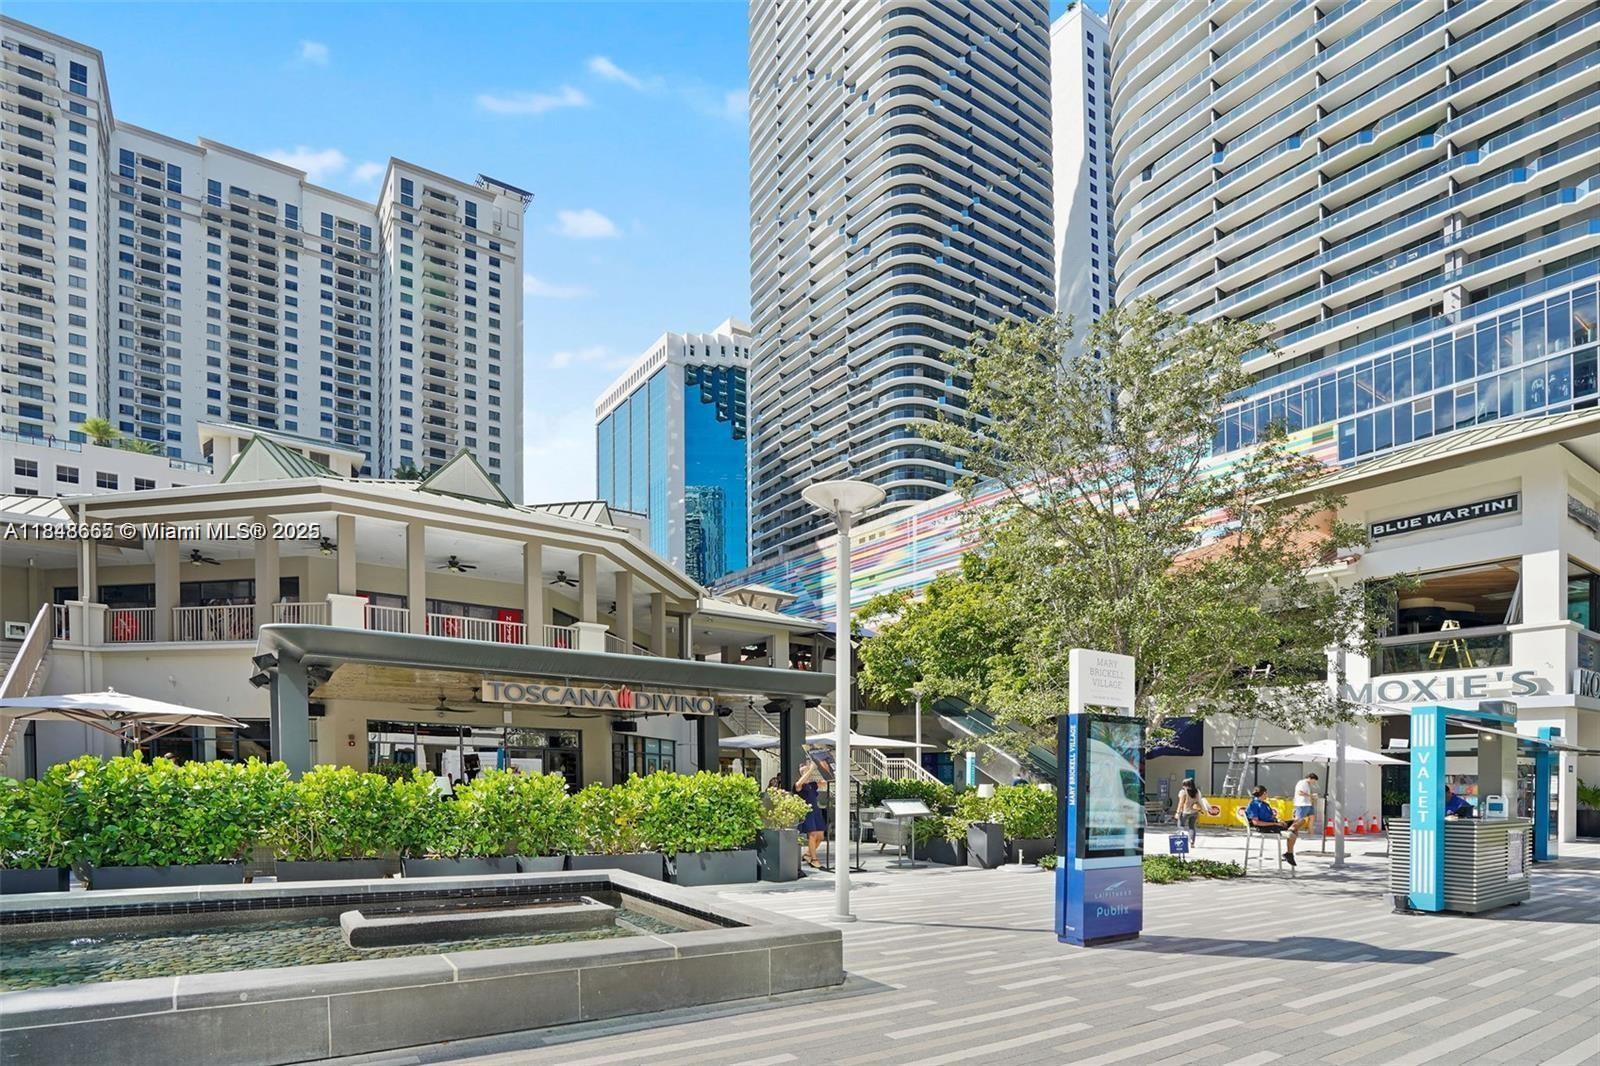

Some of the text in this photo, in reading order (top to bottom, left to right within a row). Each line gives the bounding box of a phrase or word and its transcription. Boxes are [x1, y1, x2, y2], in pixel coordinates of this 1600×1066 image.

[1372, 498, 1514, 535] BLUE MARTINI
[1089, 667, 1127, 679] BRICKELL
[1097, 658, 1118, 669] MARY
[487, 682, 714, 714] TOSCANA DIVINO
[1092, 679, 1122, 689] VILLAGE
[1344, 670, 1540, 704] MOXIE'S
[1069, 724, 1077, 752] VILLAGE
[1417, 751, 1431, 824] VALET
